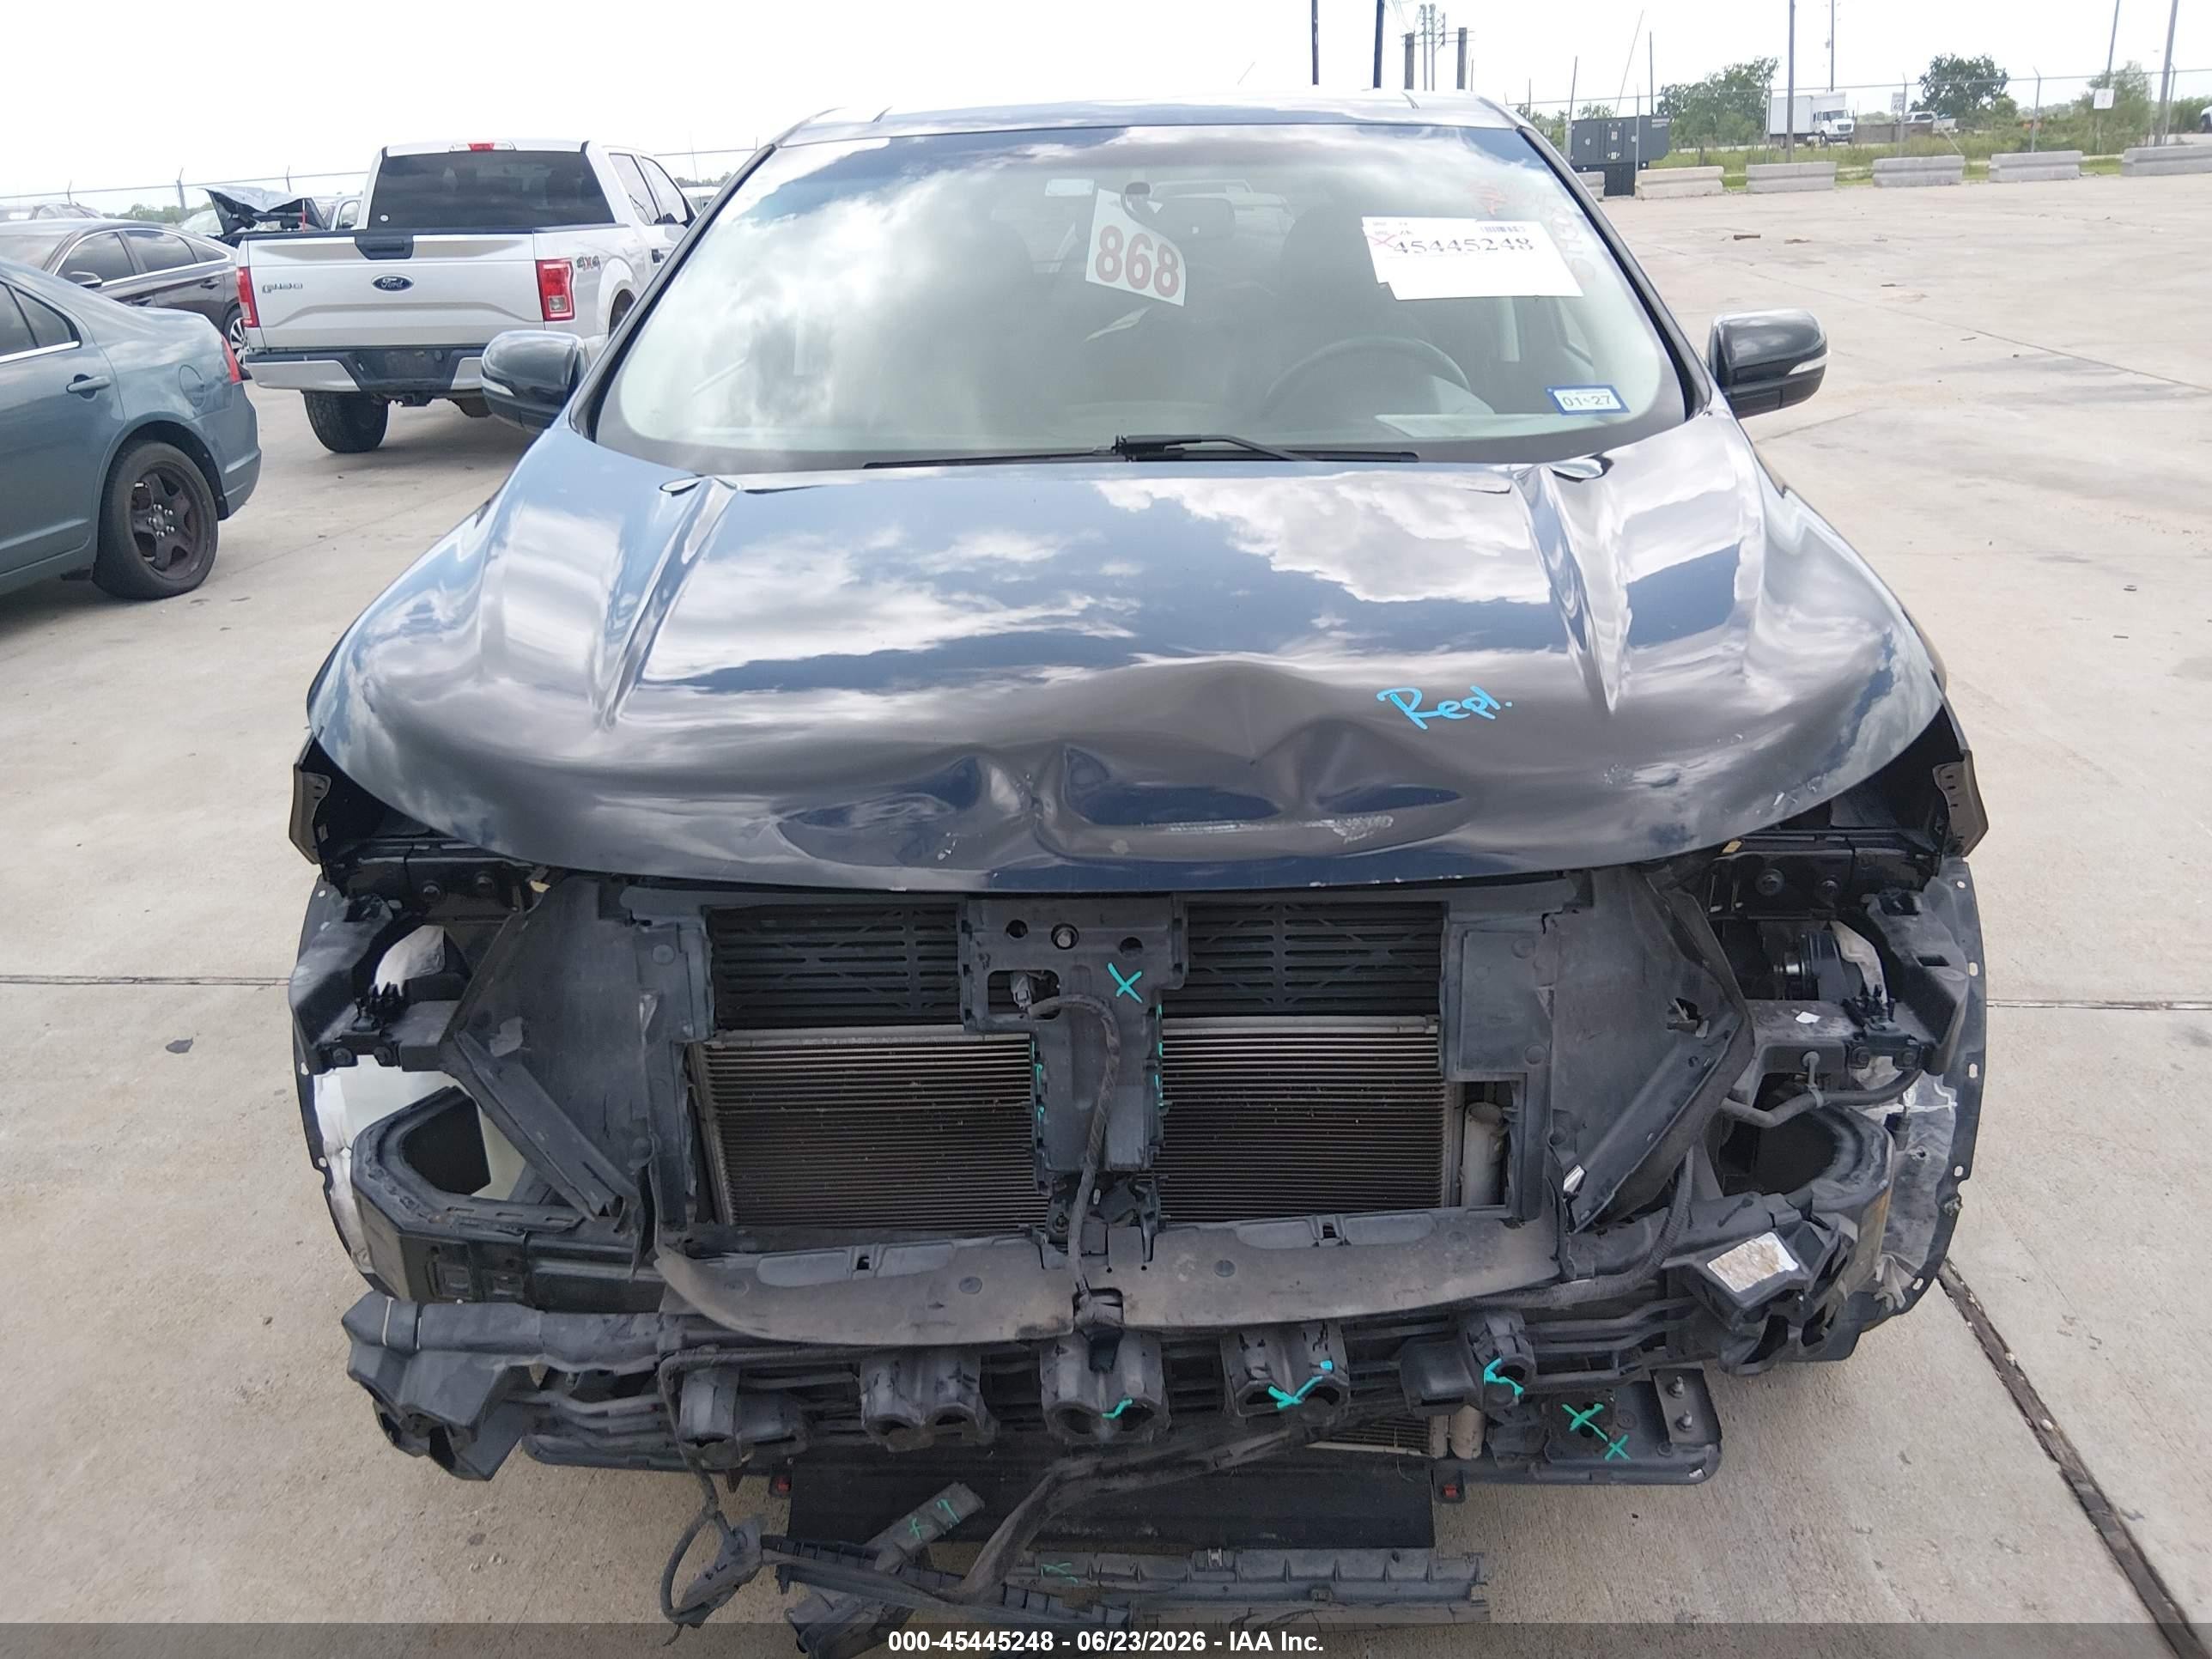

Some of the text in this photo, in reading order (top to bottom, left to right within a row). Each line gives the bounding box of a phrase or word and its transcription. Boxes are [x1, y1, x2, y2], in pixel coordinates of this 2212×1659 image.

[1392, 237, 1535, 254] 45445248
[1095, 224, 1180, 298] 868
[380, 276, 404, 289] Ford
